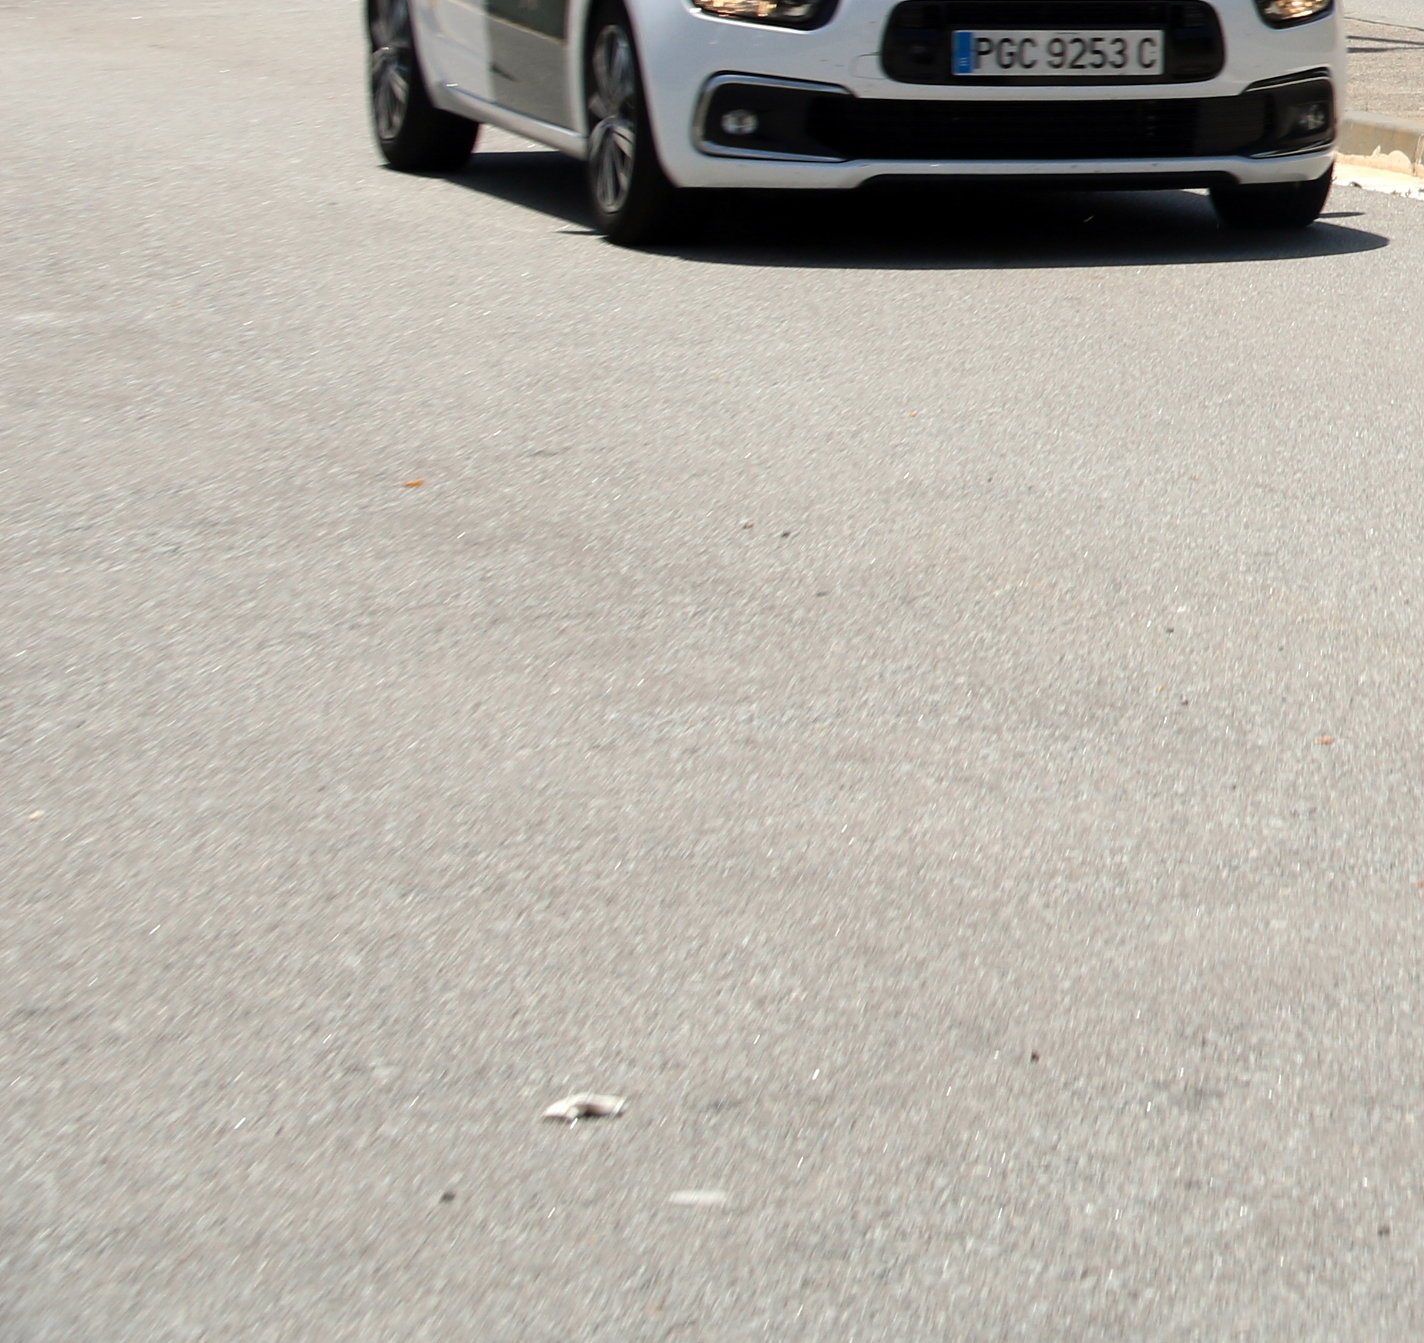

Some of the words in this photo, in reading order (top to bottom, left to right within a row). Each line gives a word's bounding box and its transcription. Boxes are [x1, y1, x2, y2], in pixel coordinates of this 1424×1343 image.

[974, 37, 1037, 69] PGC
[1047, 37, 1128, 69] 9253
[1138, 37, 1157, 69] C
